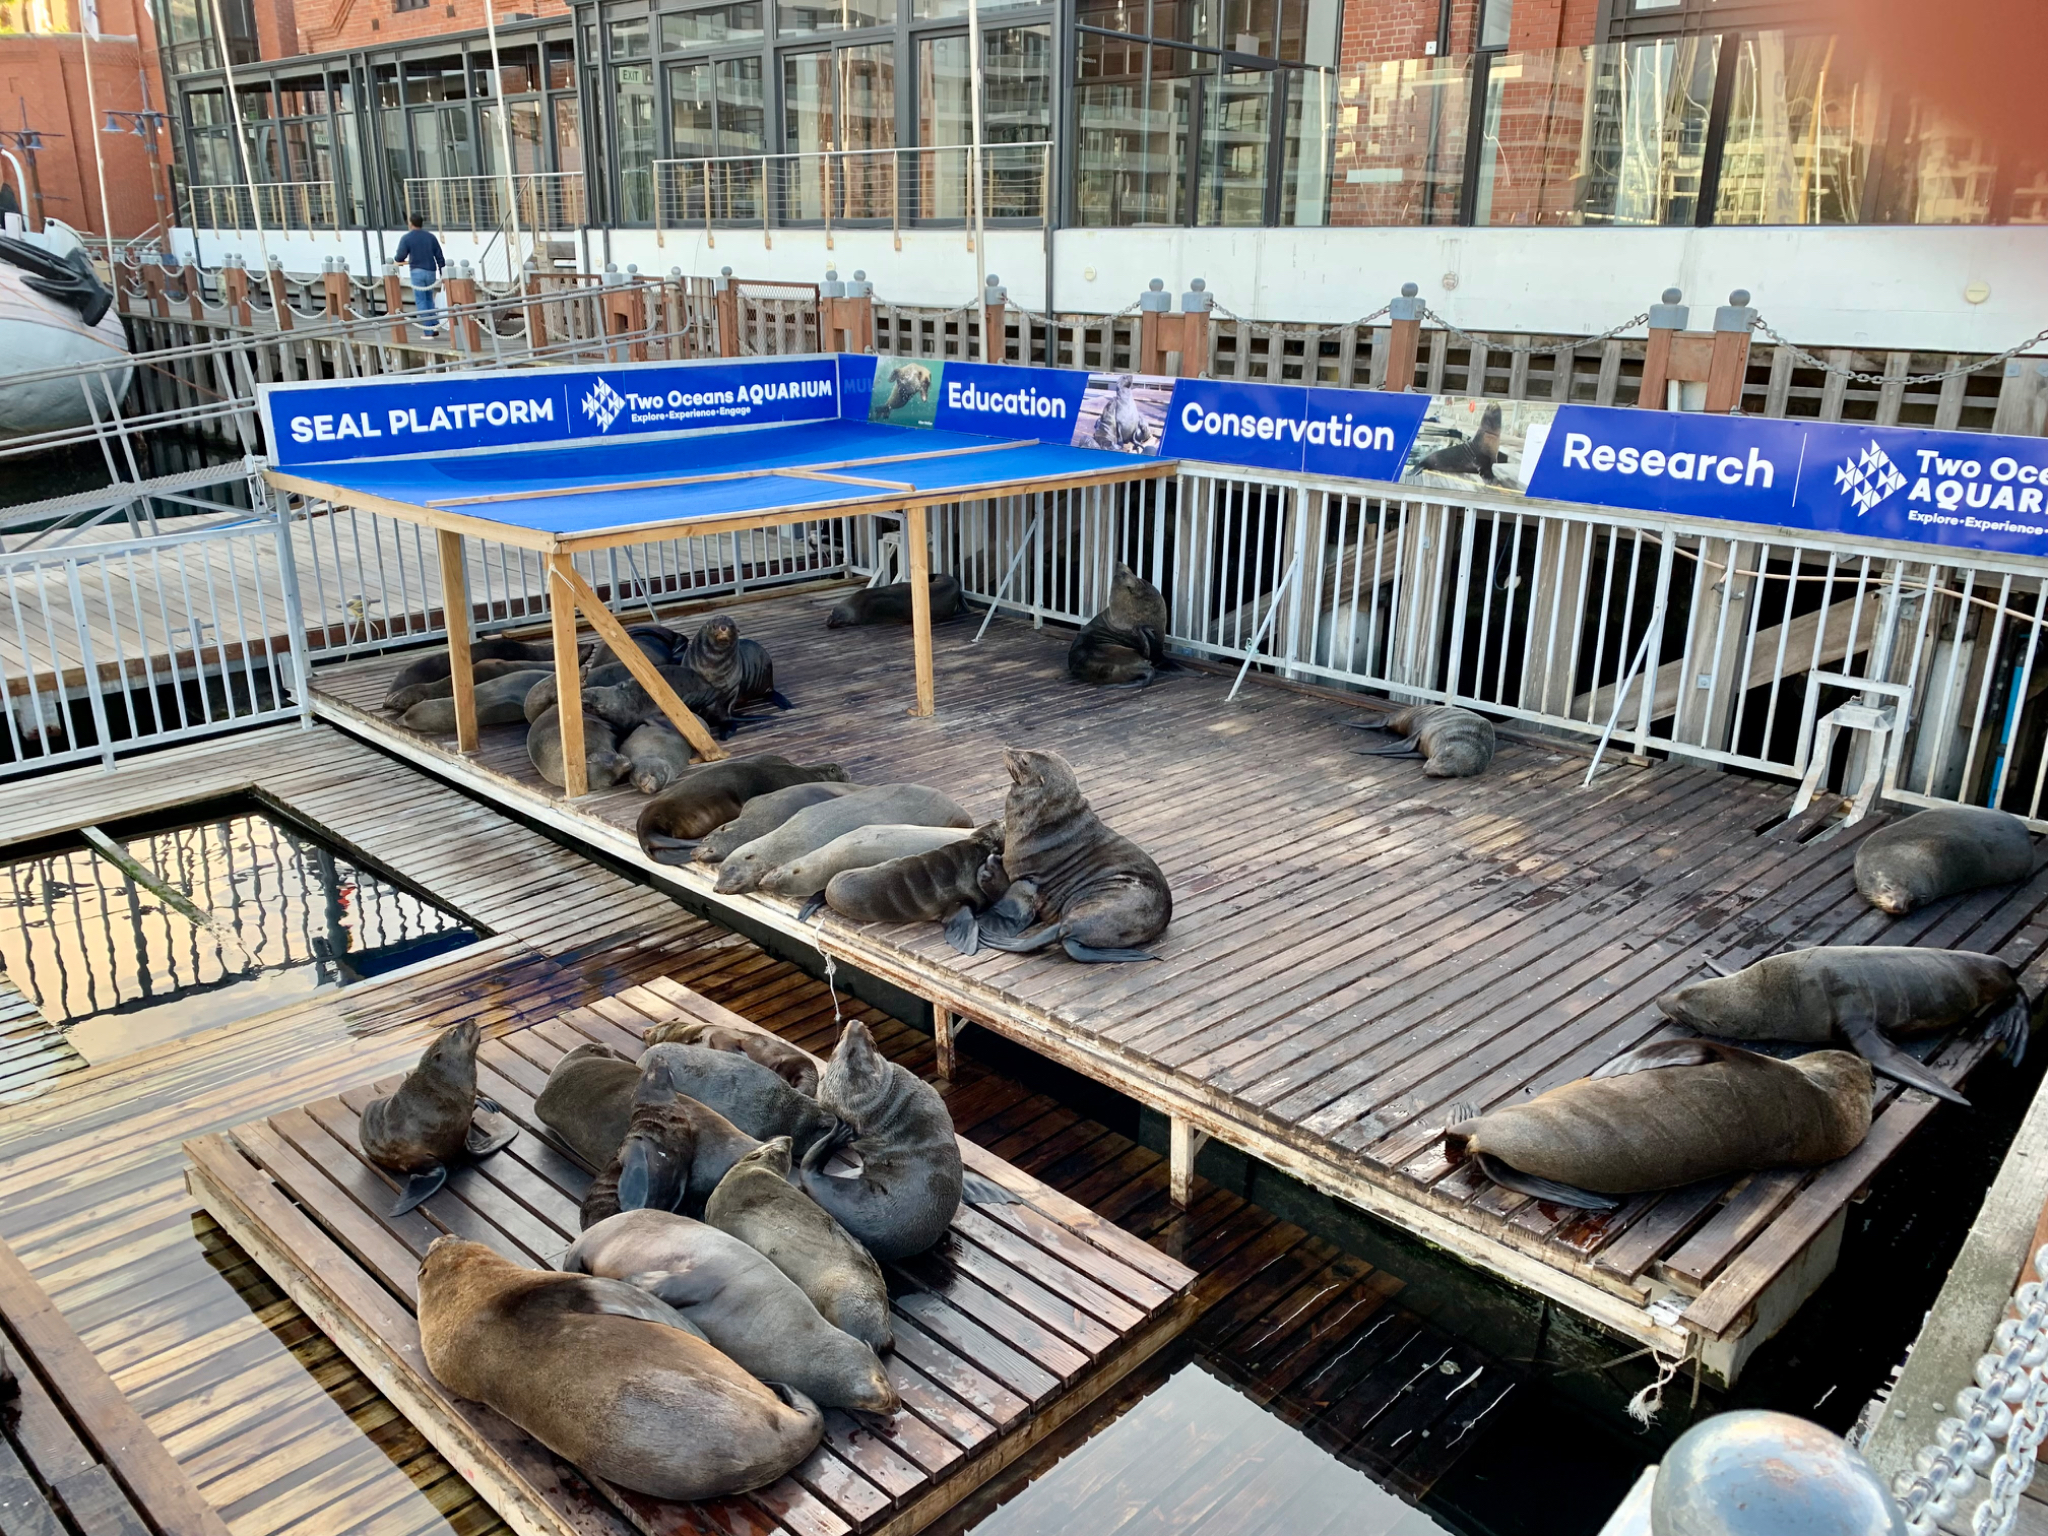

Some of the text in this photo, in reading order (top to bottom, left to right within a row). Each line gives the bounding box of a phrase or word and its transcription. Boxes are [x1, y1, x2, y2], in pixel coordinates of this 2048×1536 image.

[623, 70, 638, 81] EXIT
[625, 379, 833, 411] Two Oceans AQUARIUM
[948, 381, 1066, 419] Education
[290, 397, 554, 443] SEAL PLATFORM
[1181, 402, 1395, 451] Conservation
[1562, 432, 1775, 489] Research
[1916, 449, 1982, 479] Two
